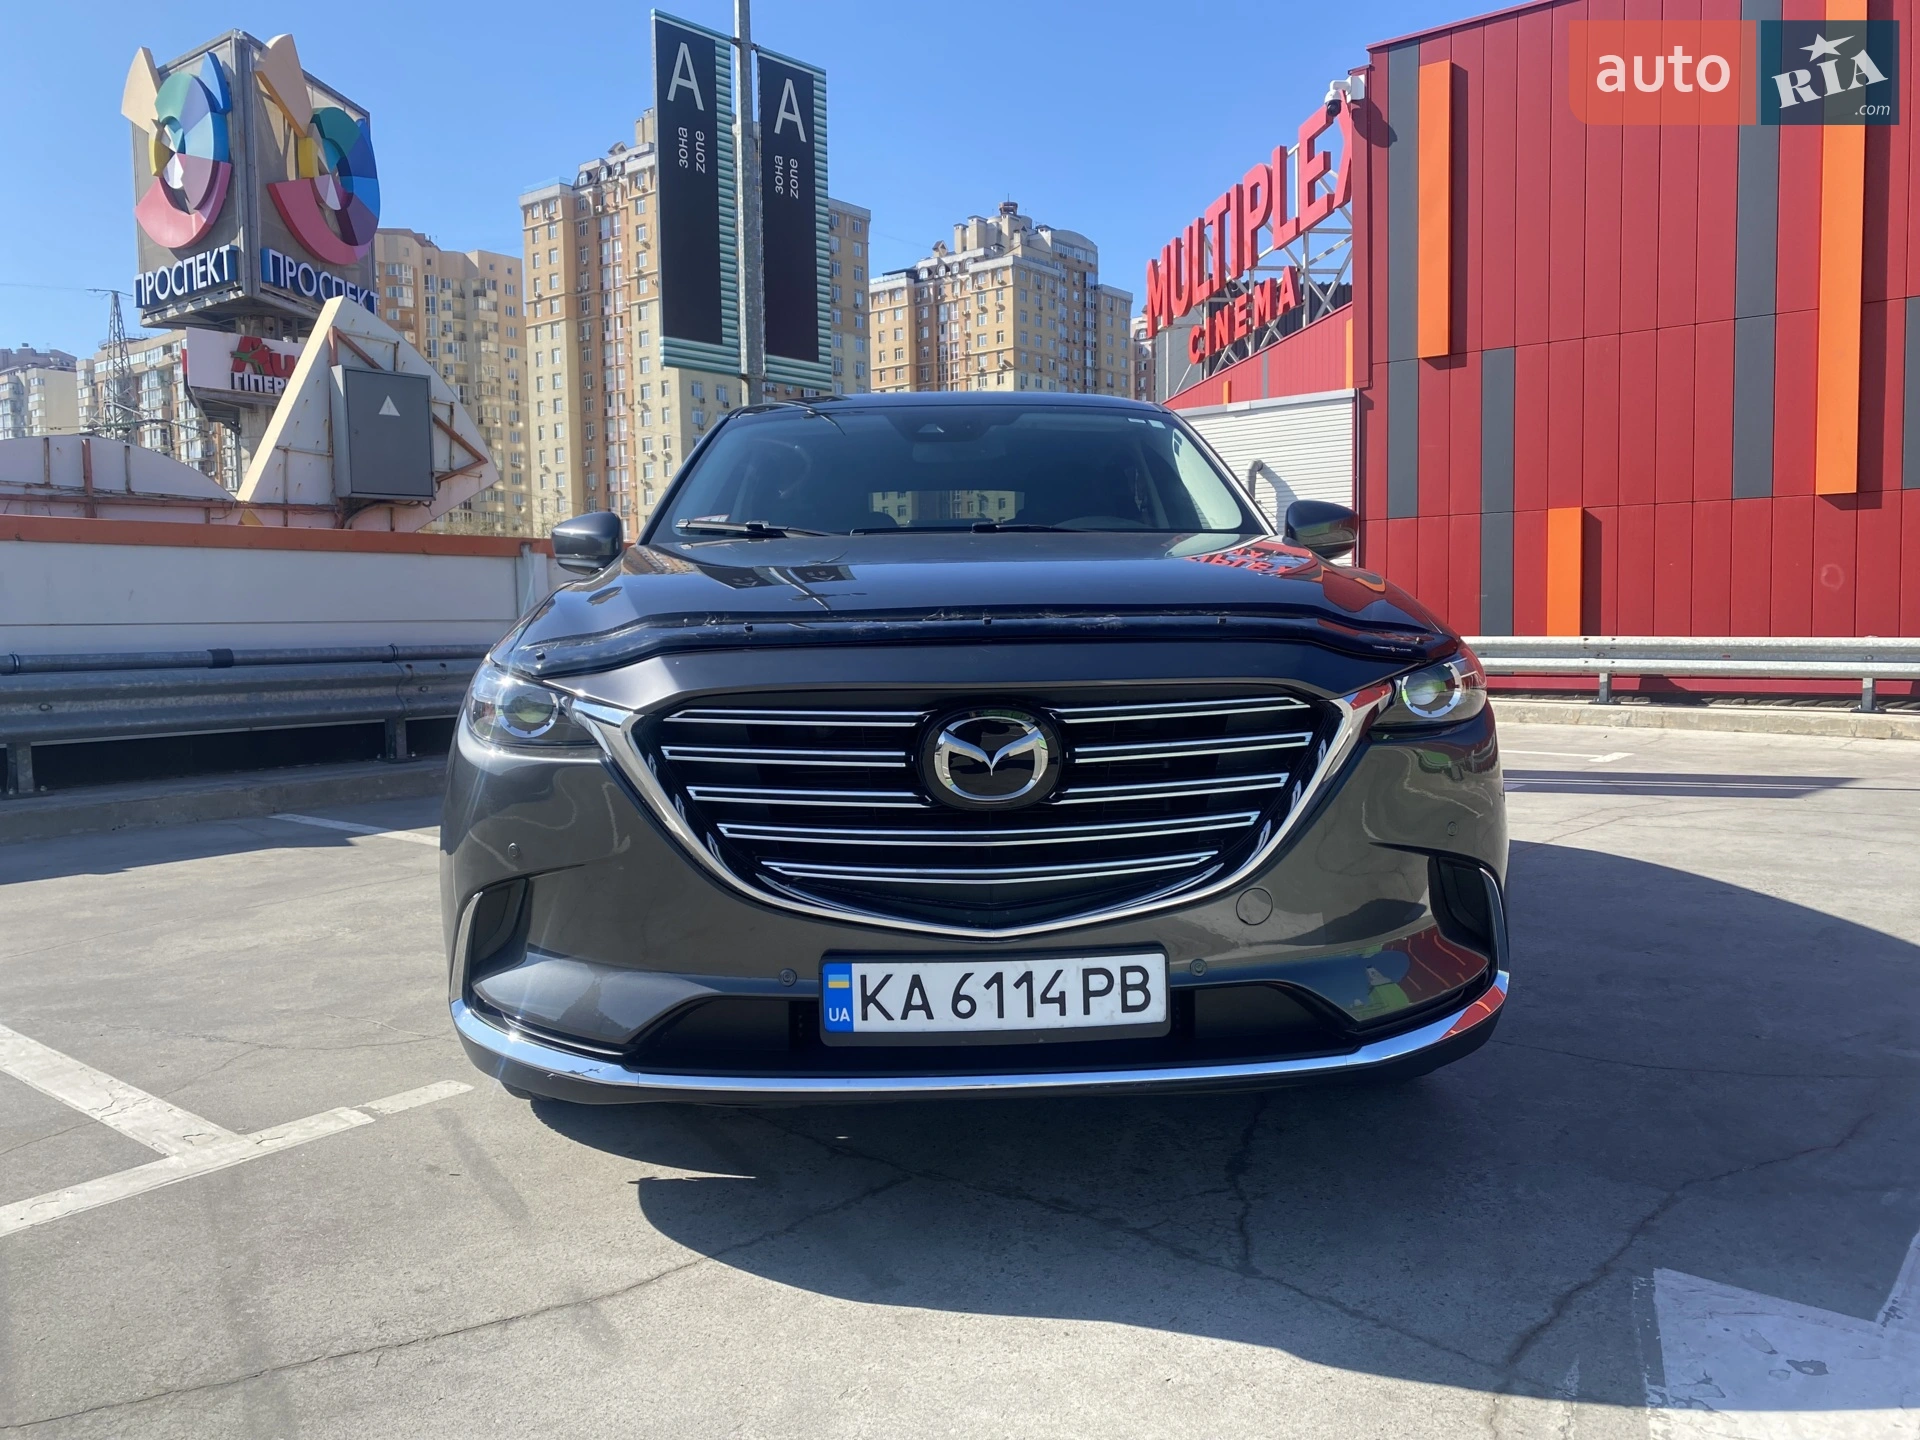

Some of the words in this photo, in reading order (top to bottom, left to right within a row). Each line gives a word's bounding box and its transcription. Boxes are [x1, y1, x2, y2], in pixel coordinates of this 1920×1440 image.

[667, 42, 704, 111] A
[774, 78, 807, 143] A
[678, 126, 689, 169] зона
[695, 130, 706, 174] zone
[774, 155, 784, 195] зона
[789, 158, 799, 200] zone
[134, 244, 230, 308] ПРОСПЕКТ
[1188, 265, 1301, 365] CINEMA
[230, 335, 300, 379] Au
[231, 372, 290, 394] ГІПЕР
[828, 1007, 851, 1022] UA
[860, 974, 935, 1021] KA
[951, 969, 1067, 1020] 6114
[1082, 965, 1151, 1015] PB
